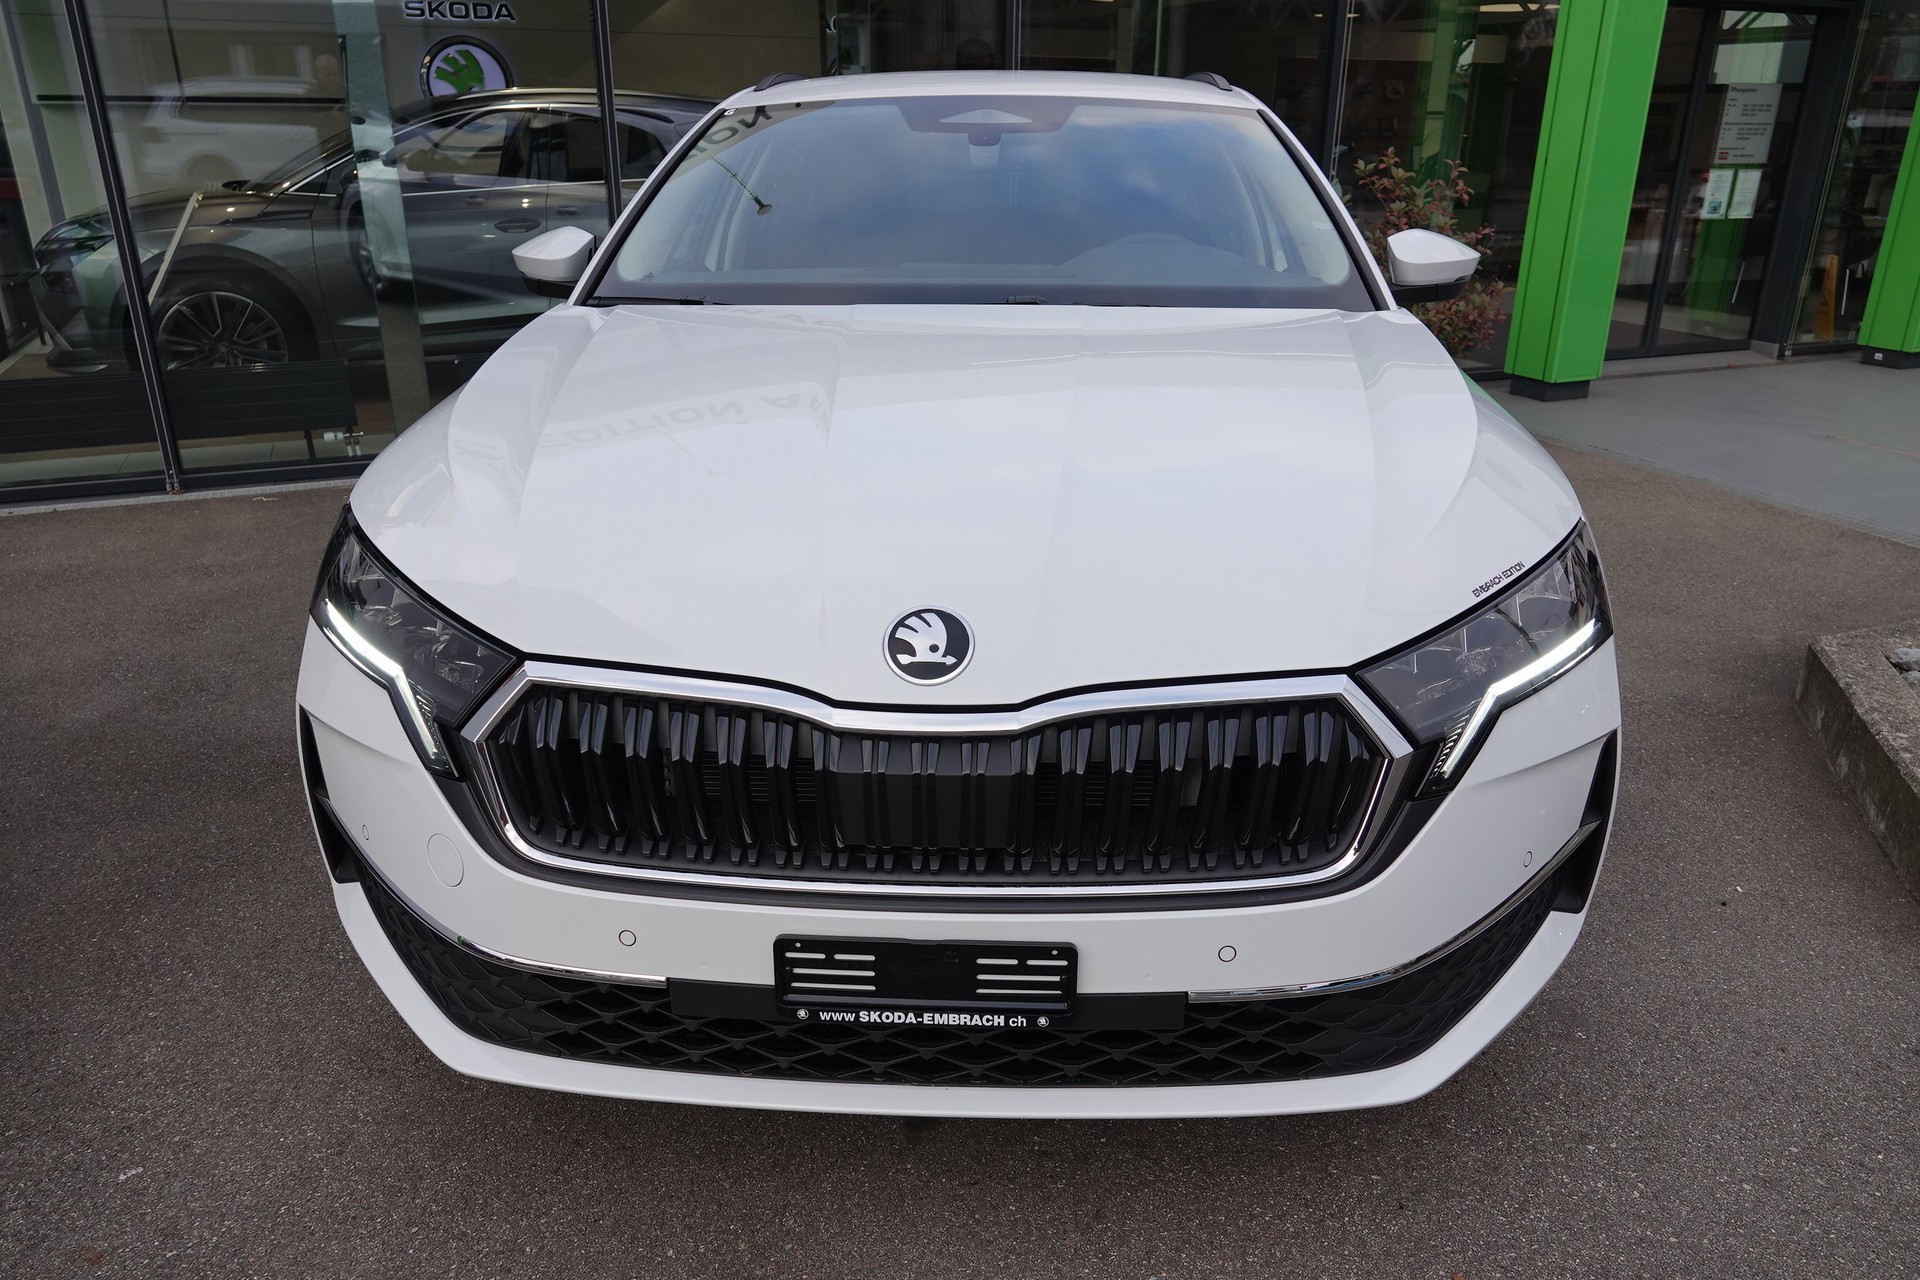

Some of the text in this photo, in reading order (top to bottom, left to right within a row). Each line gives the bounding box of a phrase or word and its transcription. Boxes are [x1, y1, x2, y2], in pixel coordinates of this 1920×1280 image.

[1471, 560, 1526, 598] EMBRACH EDITION
[819, 1010, 1027, 1027] www SKODA-EMBRACH ch
